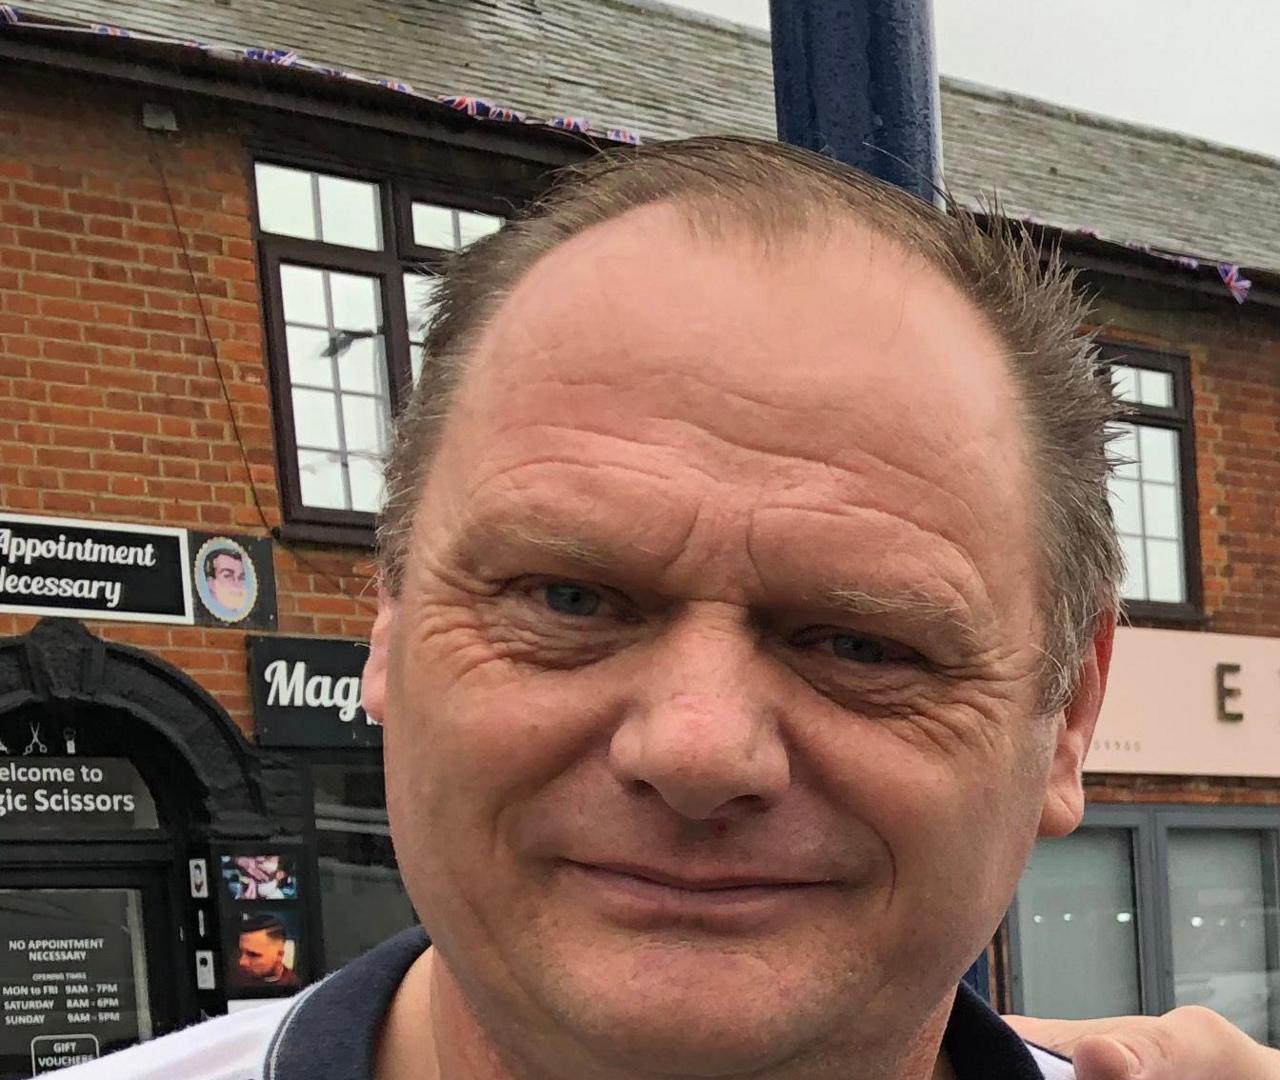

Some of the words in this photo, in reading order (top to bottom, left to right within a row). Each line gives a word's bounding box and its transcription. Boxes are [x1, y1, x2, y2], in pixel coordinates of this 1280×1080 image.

[80, 765, 103, 783] to
[34, 788, 135, 812] Scissors
[9, 940, 25, 951] NO
[28, 938, 104, 950] APPOINTMENT
[29, 951, 87, 961] NECESSARY
[2, 986, 28, 996] MON
[4, 1000, 54, 1011] SATURDAY
[5, 1014, 45, 1025] SUNDAY
[53, 1041, 77, 1053] GIFT
